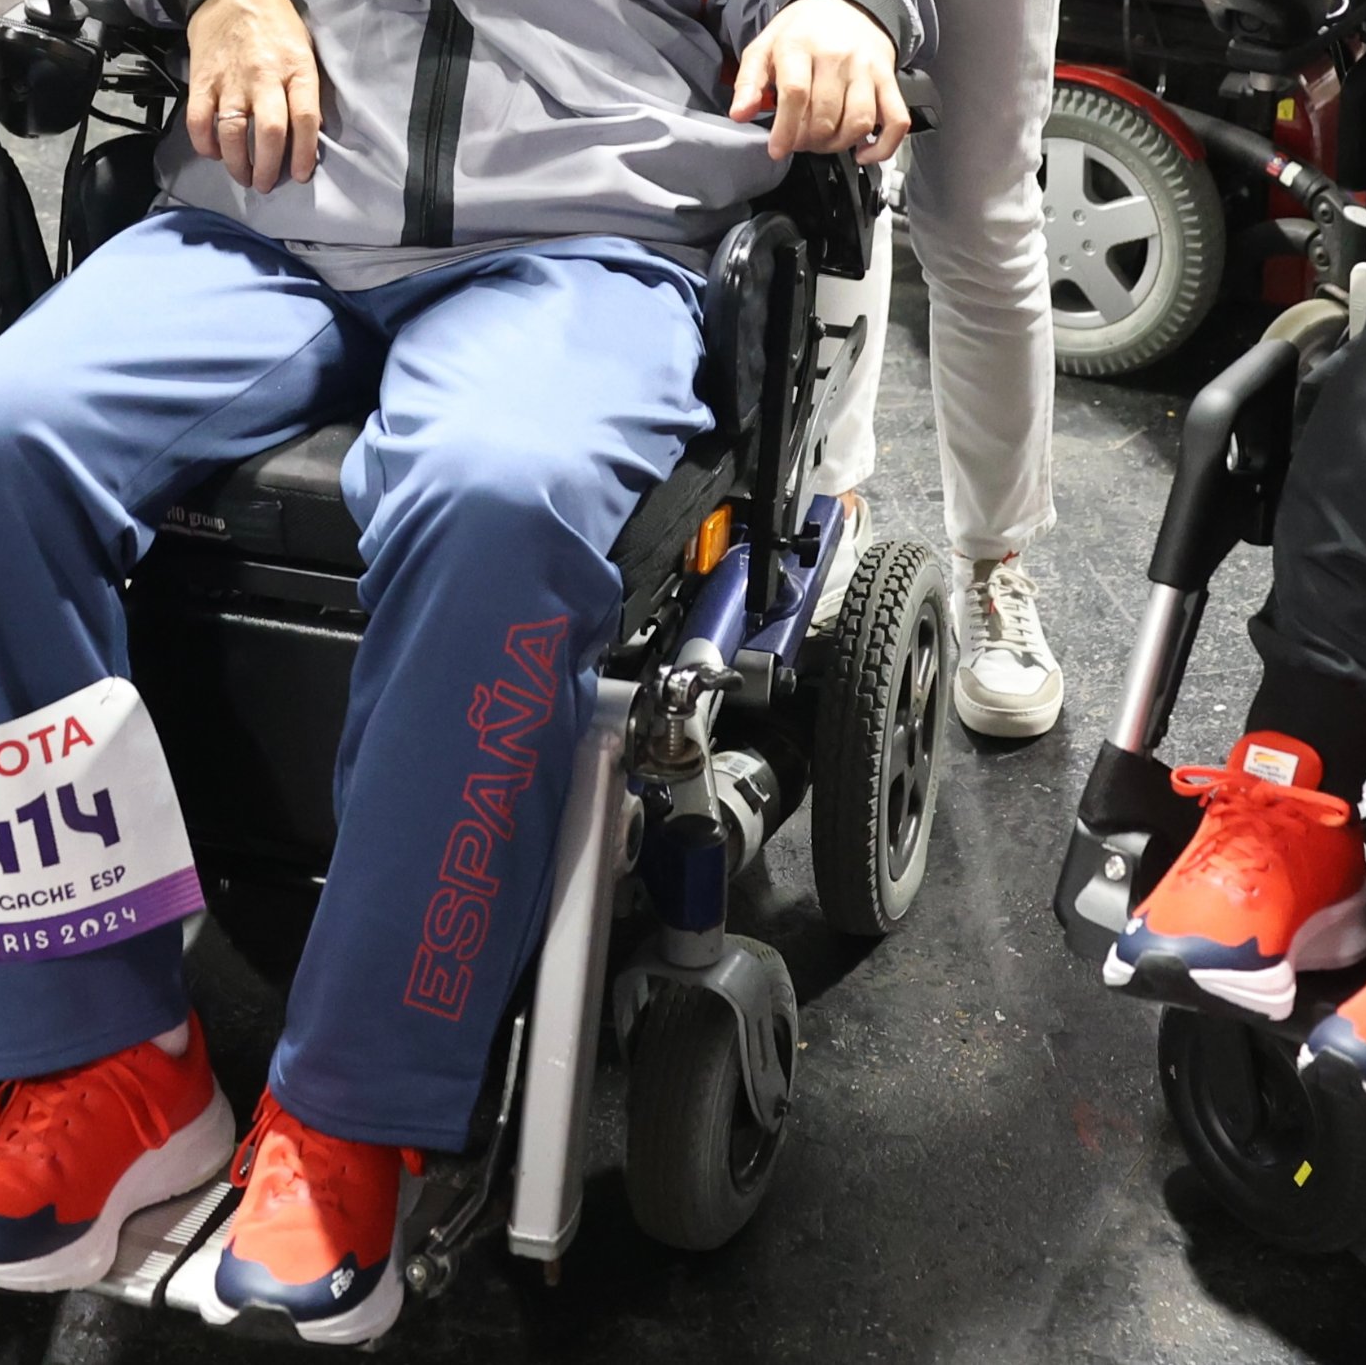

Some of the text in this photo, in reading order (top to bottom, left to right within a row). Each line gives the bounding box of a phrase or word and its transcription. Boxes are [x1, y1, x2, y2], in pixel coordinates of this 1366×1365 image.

[403, 615, 569, 1022] ESPAÑA
[90, 865, 127, 892] ESP
[60, 906, 137, 944] 2024
